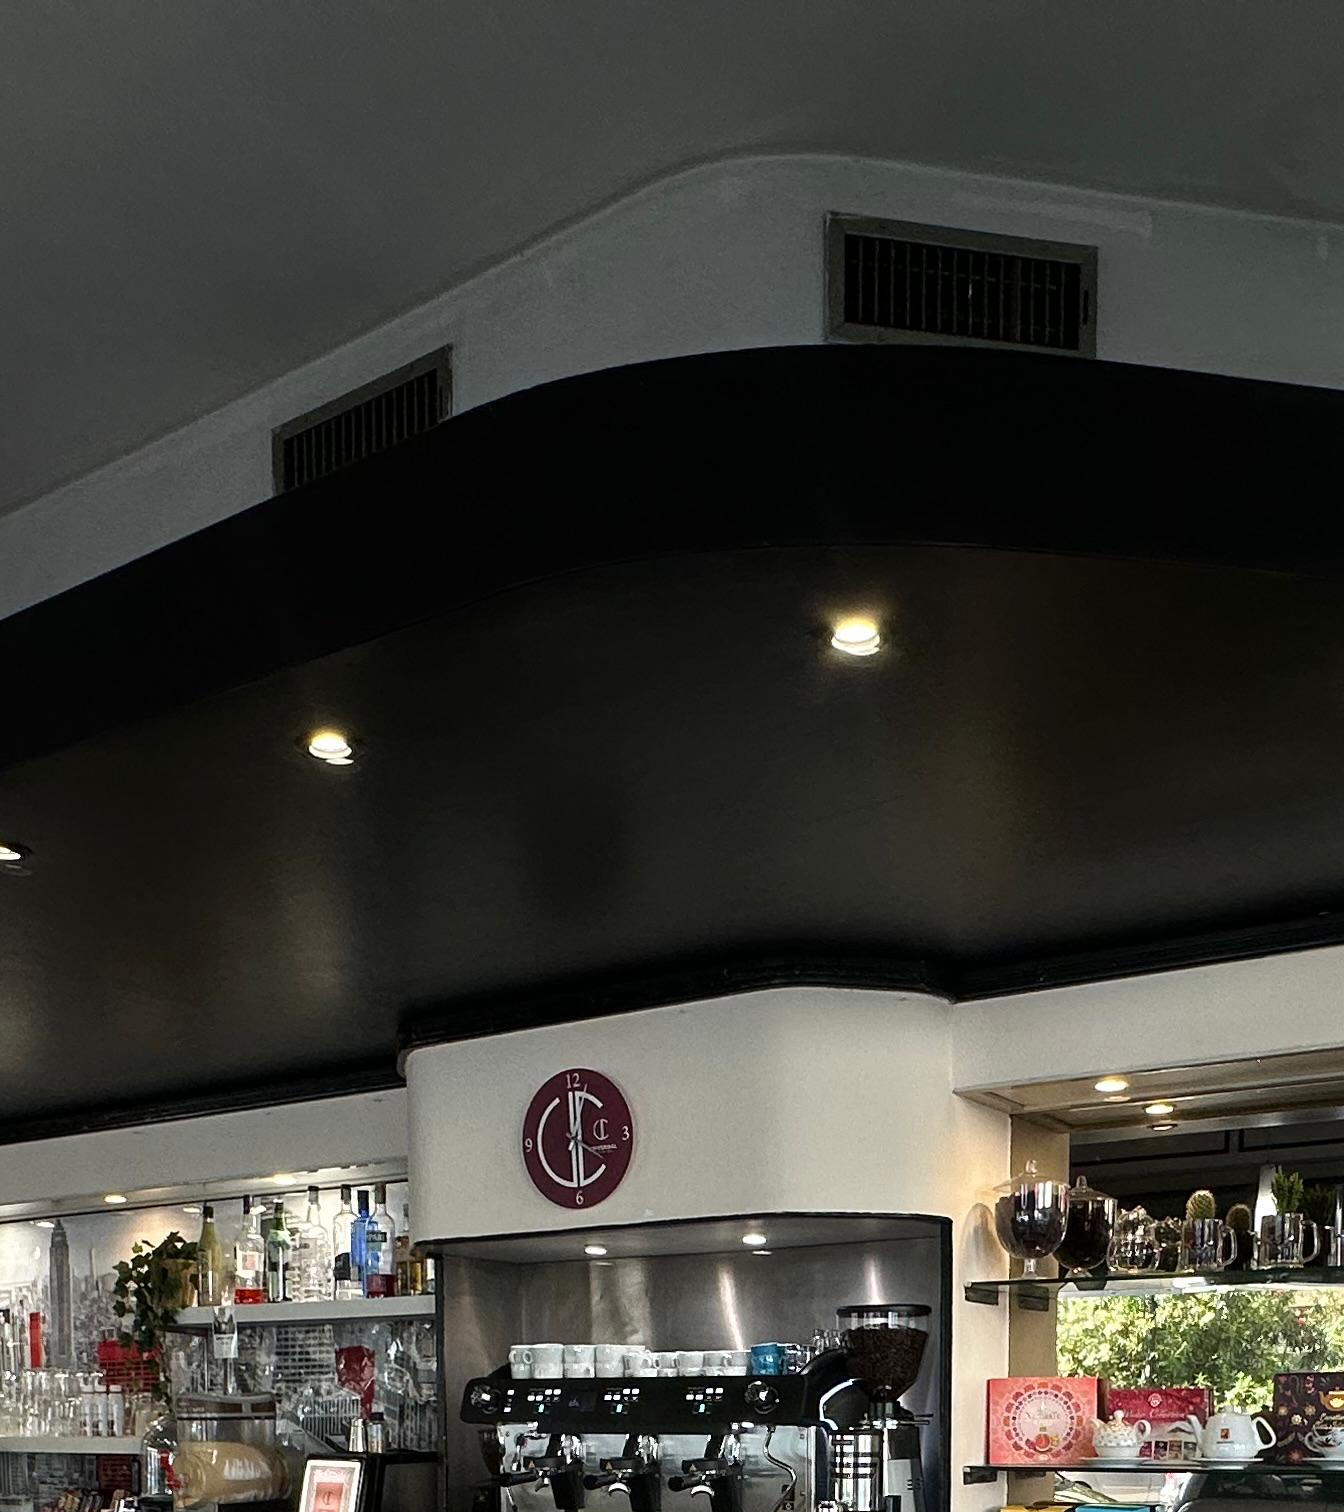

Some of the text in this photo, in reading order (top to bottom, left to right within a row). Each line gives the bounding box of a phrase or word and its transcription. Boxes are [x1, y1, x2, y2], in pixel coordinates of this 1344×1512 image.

[566, 1073, 580, 1088] 12
[622, 1125, 630, 1140] 3
[524, 1138, 533, 1152] 9
[576, 1190, 584, 1205] 6
